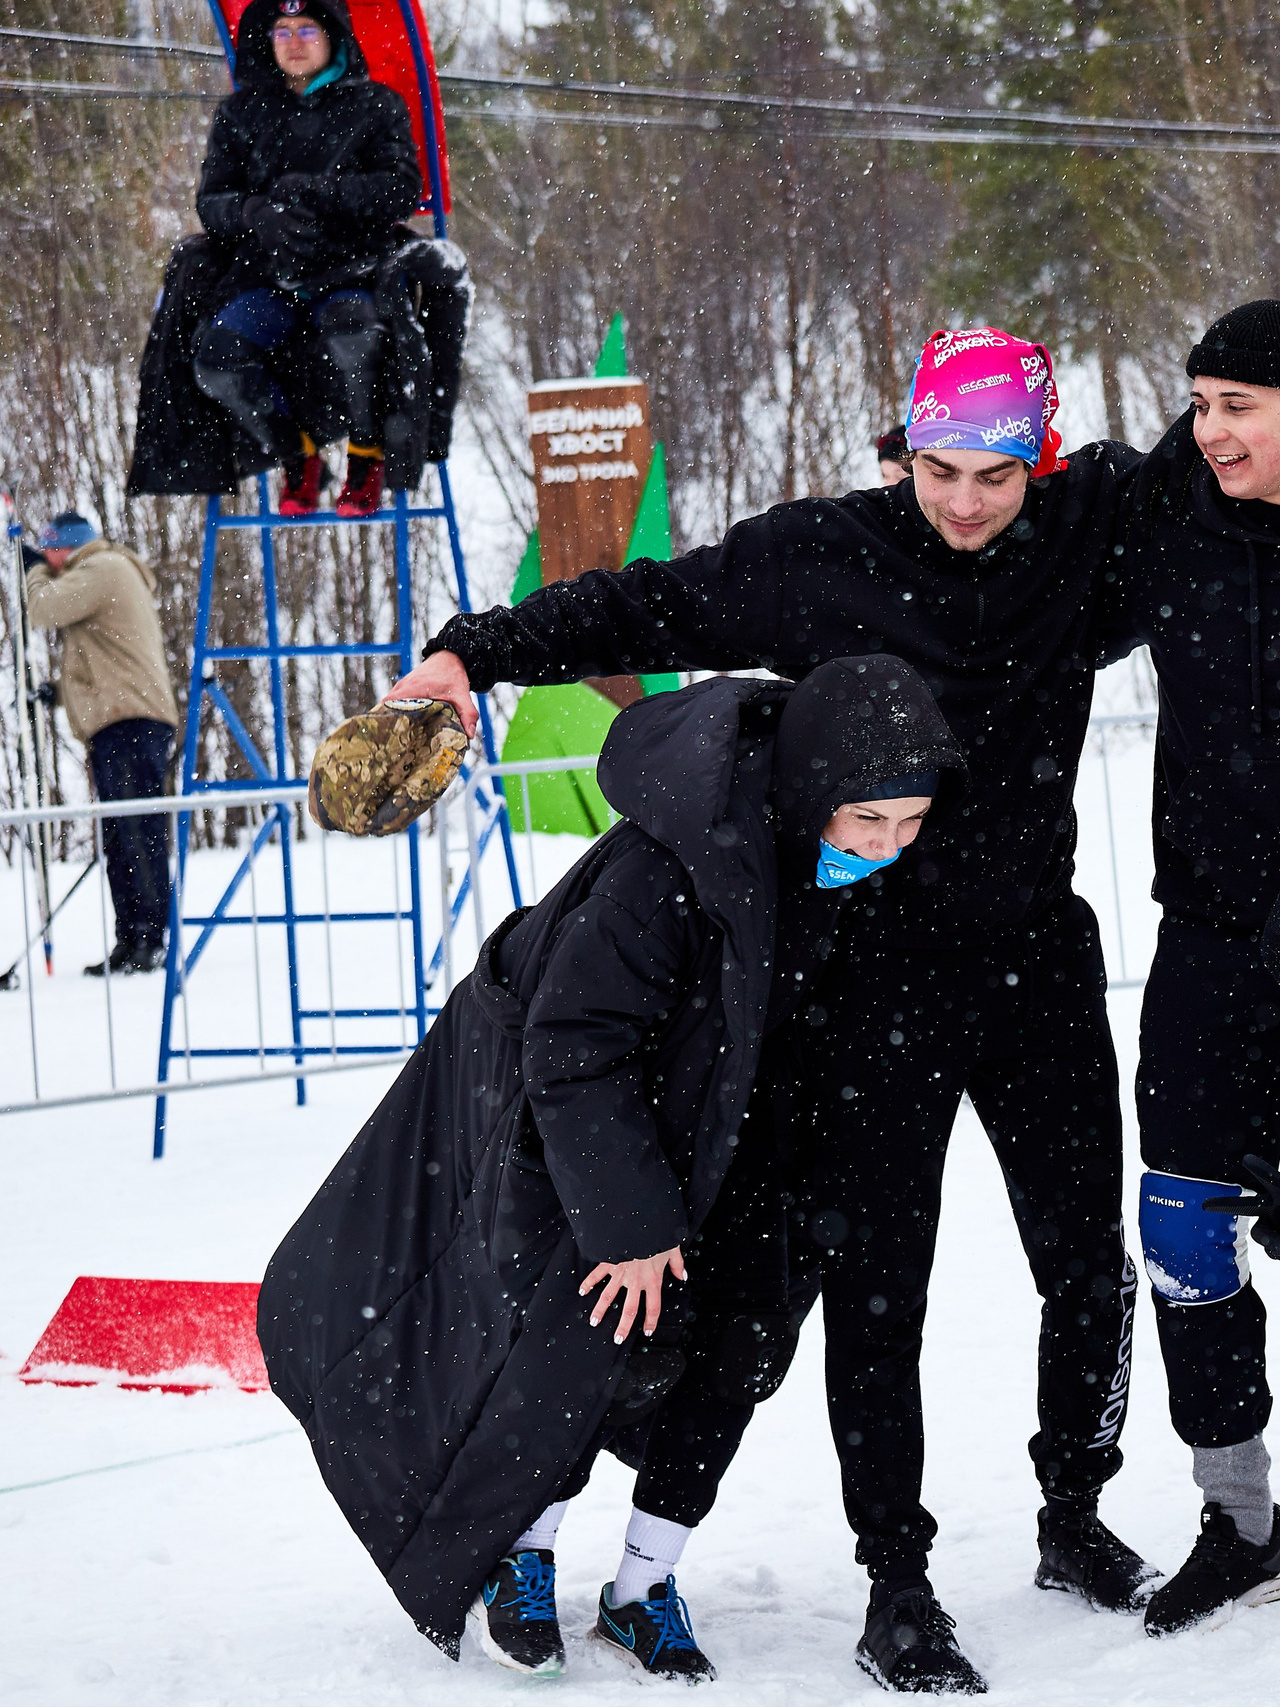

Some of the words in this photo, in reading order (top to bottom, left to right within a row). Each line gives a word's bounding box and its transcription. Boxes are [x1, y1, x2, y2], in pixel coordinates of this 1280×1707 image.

[530, 401, 645, 435] БЕЛИЧИЙ
[547, 429, 628, 457] ХВОСТ
[577, 460, 640, 482] ТРОПА
[1148, 1194, 1185, 1209] VIKING
